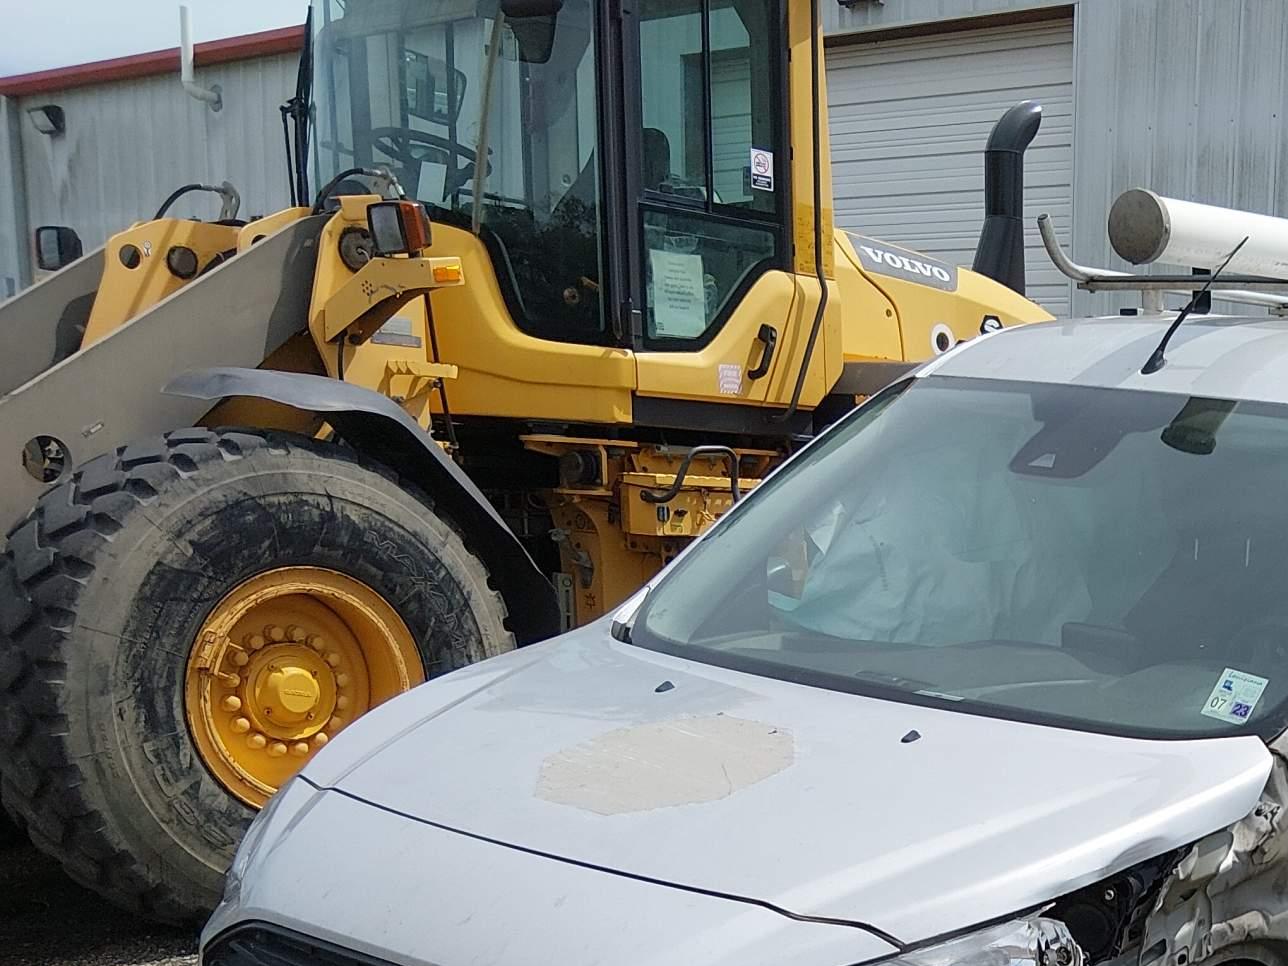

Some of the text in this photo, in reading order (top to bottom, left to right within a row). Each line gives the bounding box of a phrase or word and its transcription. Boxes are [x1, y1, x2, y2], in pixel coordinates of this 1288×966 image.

[860, 245, 950, 281] VOLVO
[1211, 697, 1227, 710] 07
[1232, 703, 1249, 717] 23
